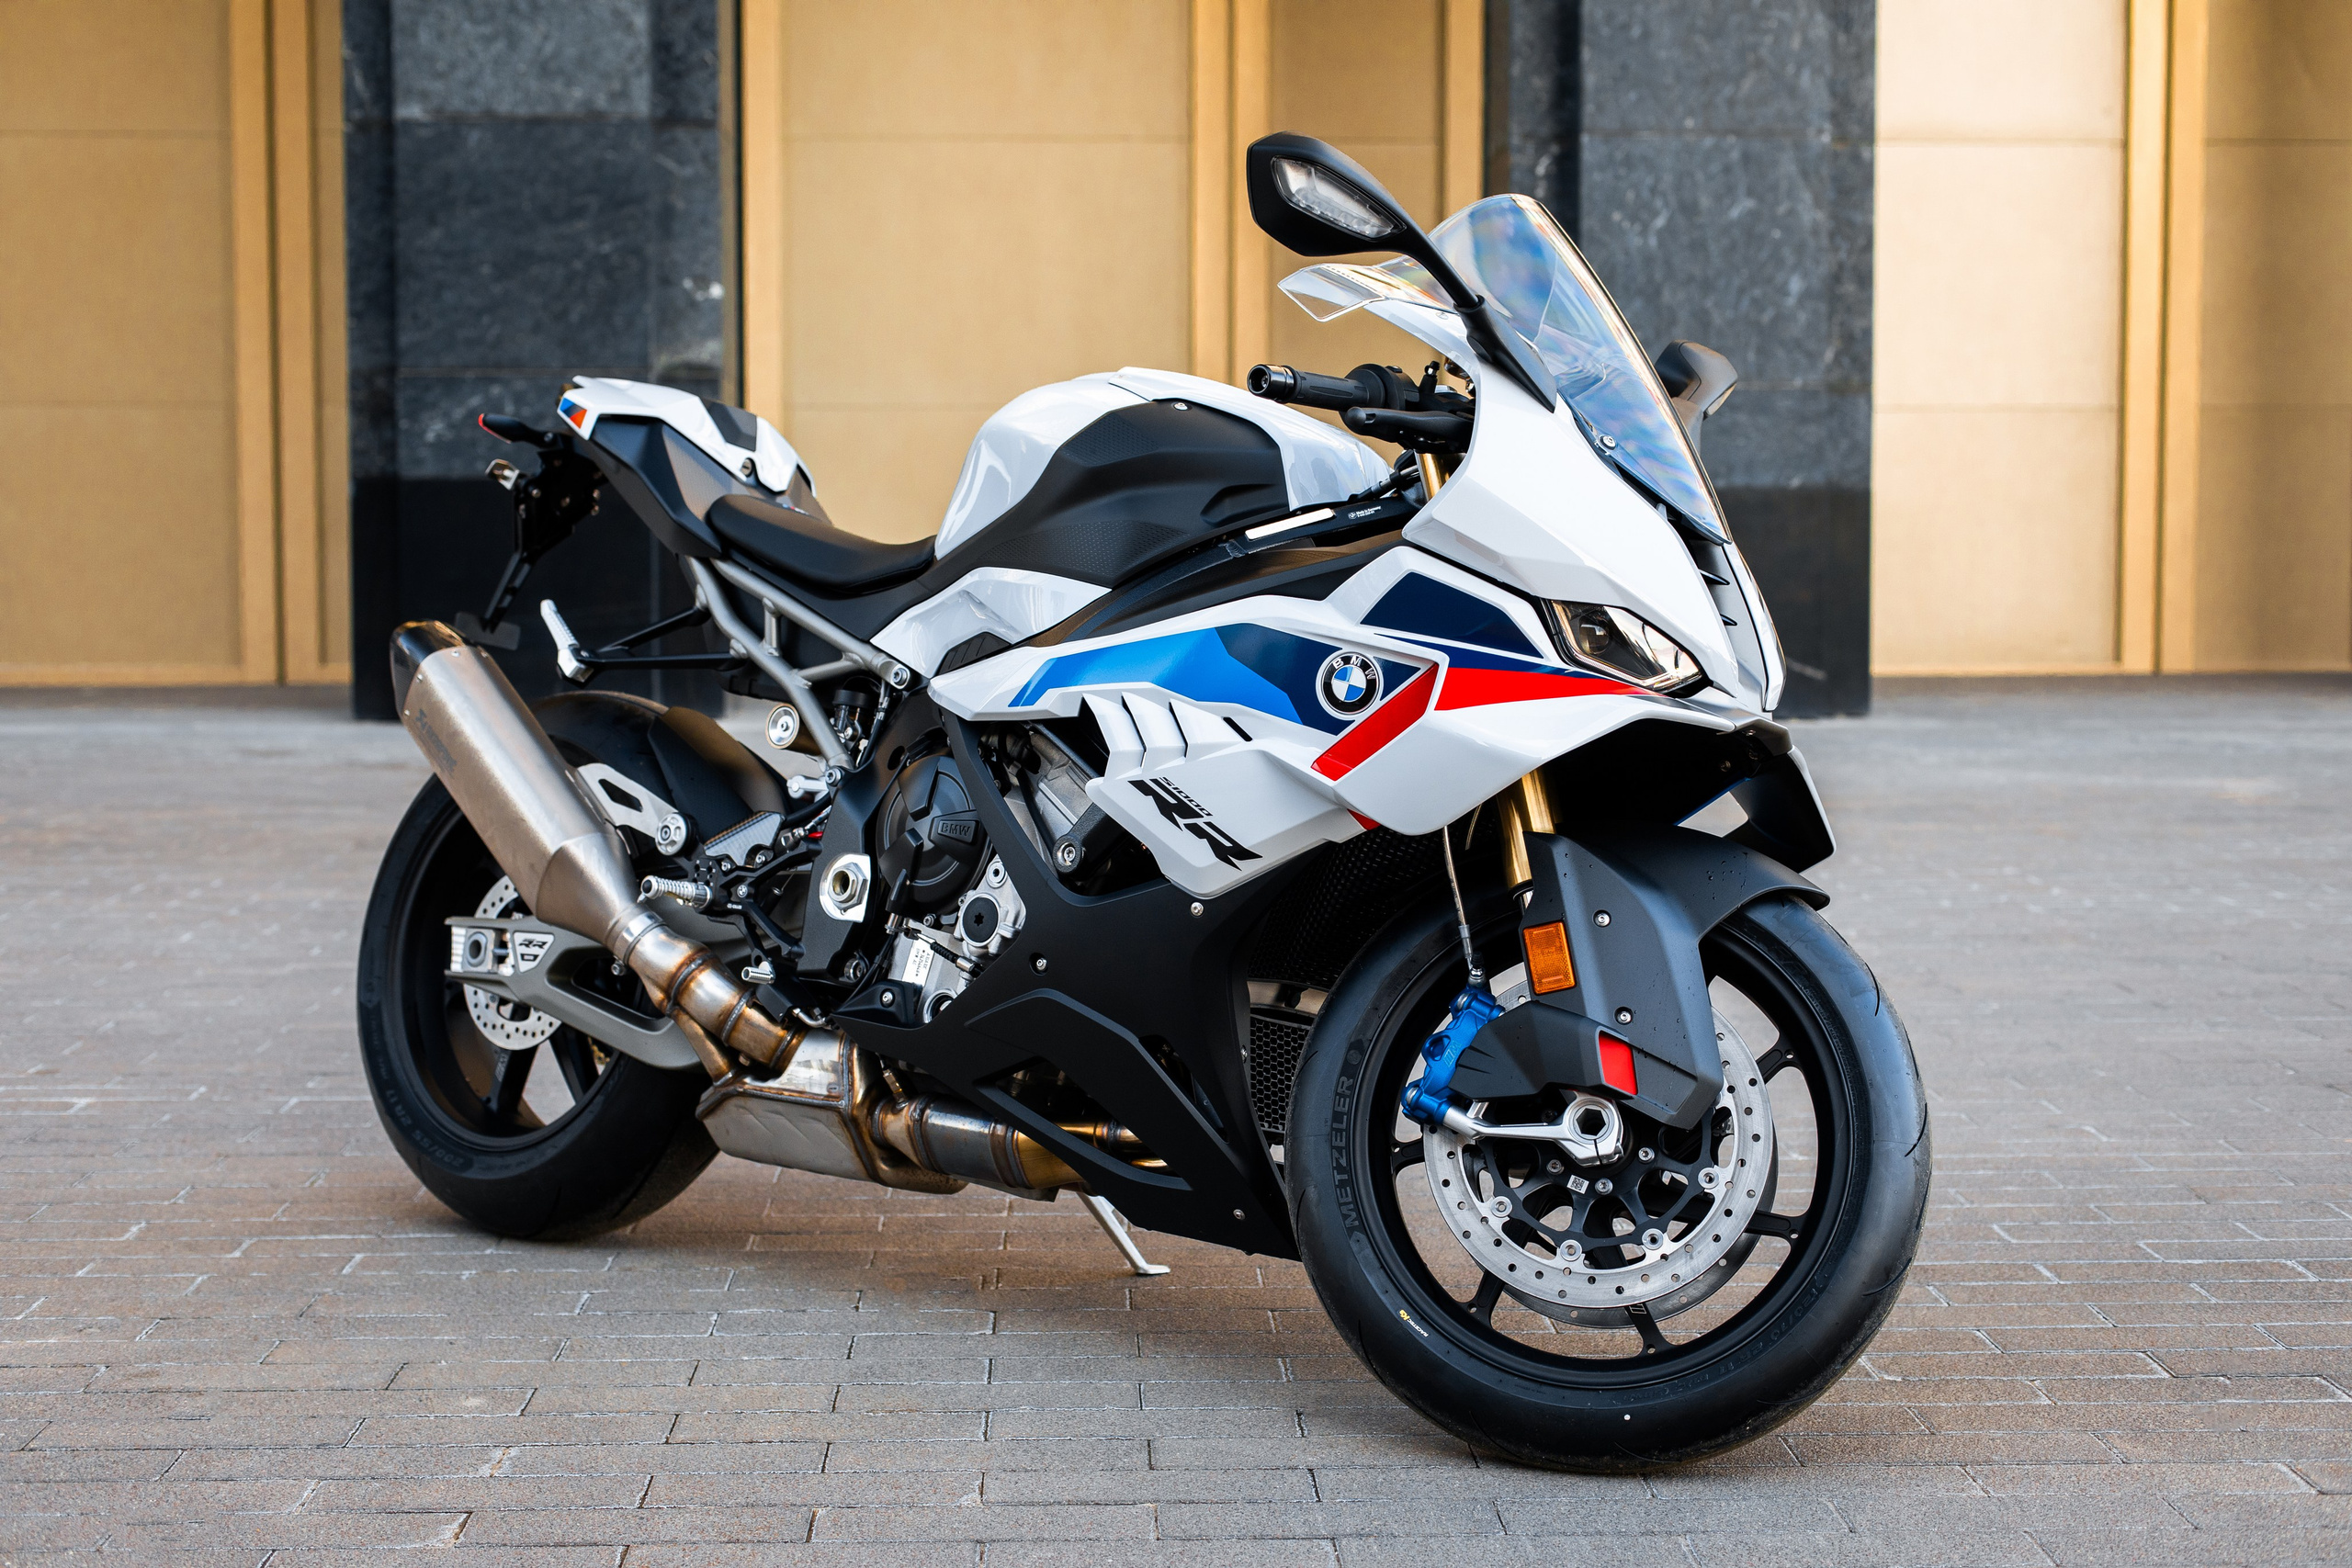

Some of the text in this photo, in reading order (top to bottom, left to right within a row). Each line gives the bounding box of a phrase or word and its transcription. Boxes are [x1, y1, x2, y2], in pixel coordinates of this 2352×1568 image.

[1332, 655, 1376, 680] BMW
[1159, 777, 1213, 817] S1000
[942, 822, 971, 837] BMW
[1127, 778, 1263, 872] RR
[1332, 1076, 1359, 1228] METZELER
